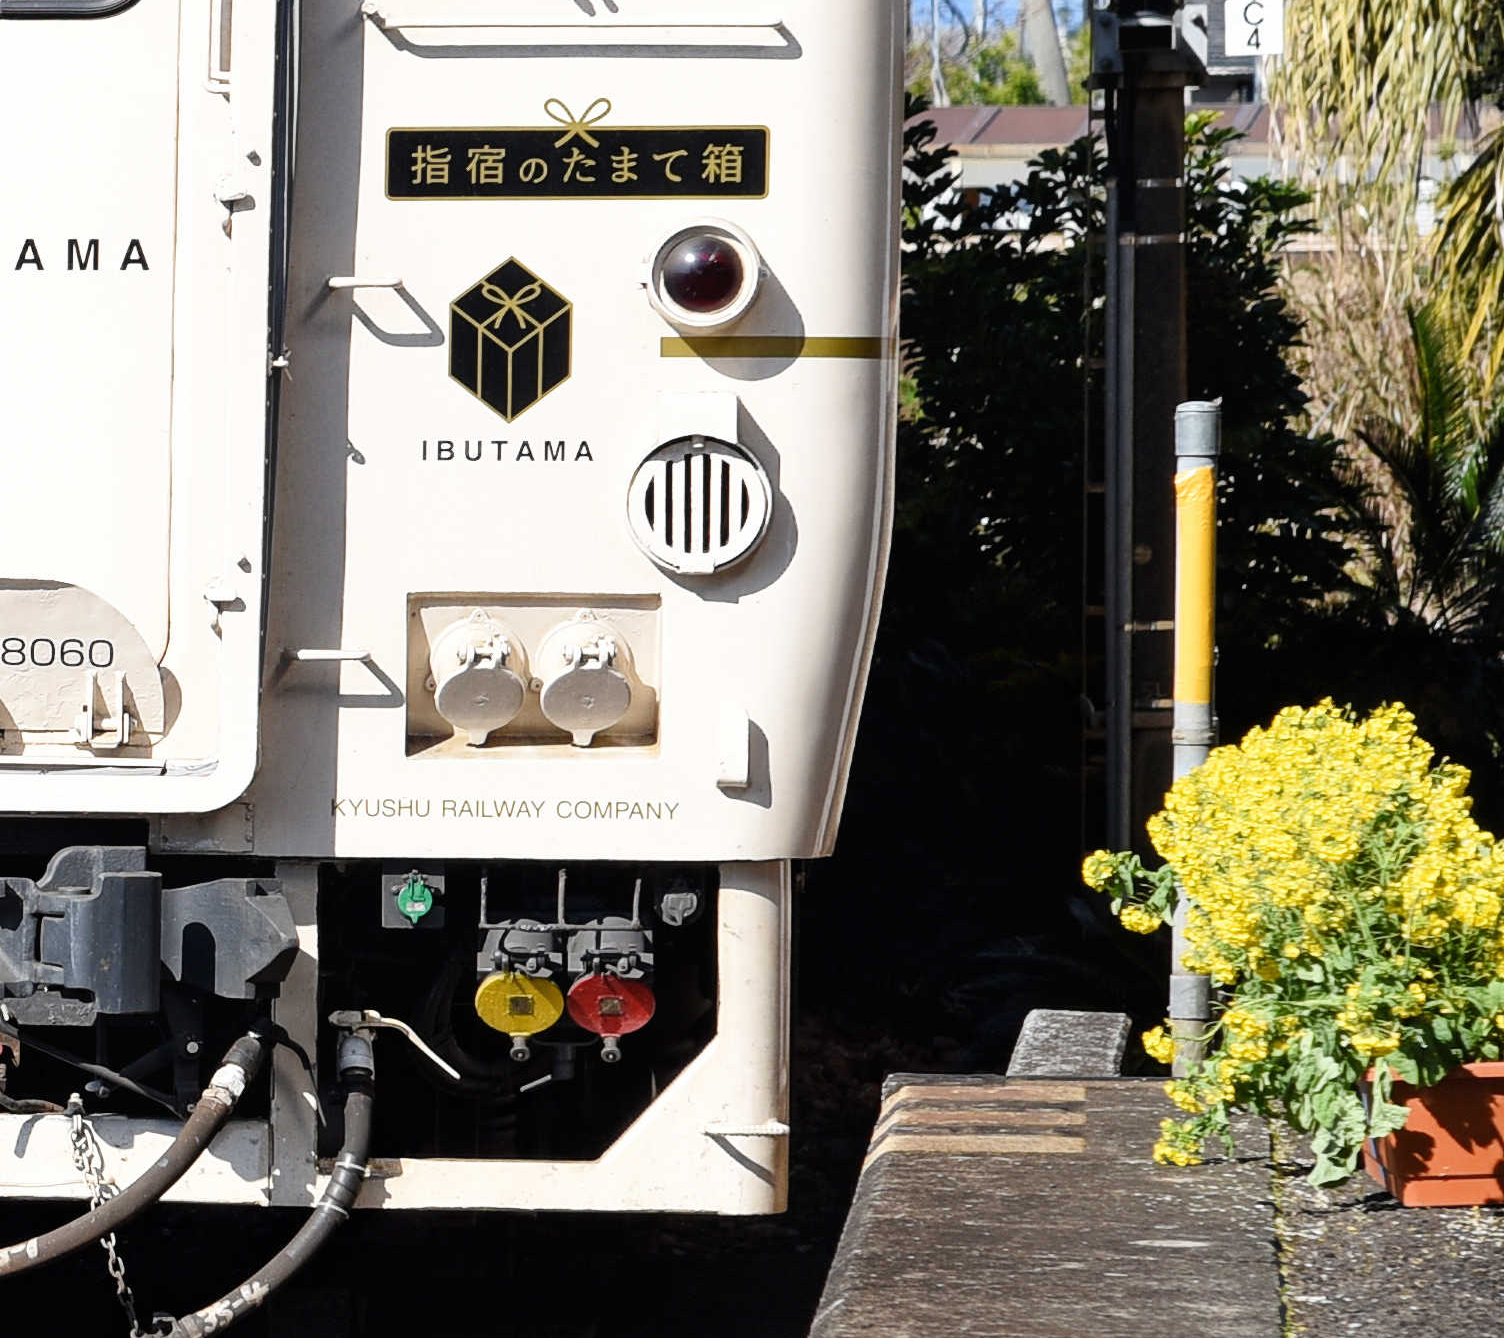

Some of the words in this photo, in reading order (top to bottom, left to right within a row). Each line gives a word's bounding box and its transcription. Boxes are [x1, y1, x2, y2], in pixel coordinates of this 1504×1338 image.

[411, 142, 744, 186] 指宿のたまて箱
[422, 439, 595, 463] IBUTAMA
[1, 638, 113, 667] 8060
[330, 798, 431, 818] KYUSHU
[443, 799, 546, 819] RAILWAY
[556, 800, 680, 820] COMPANY
